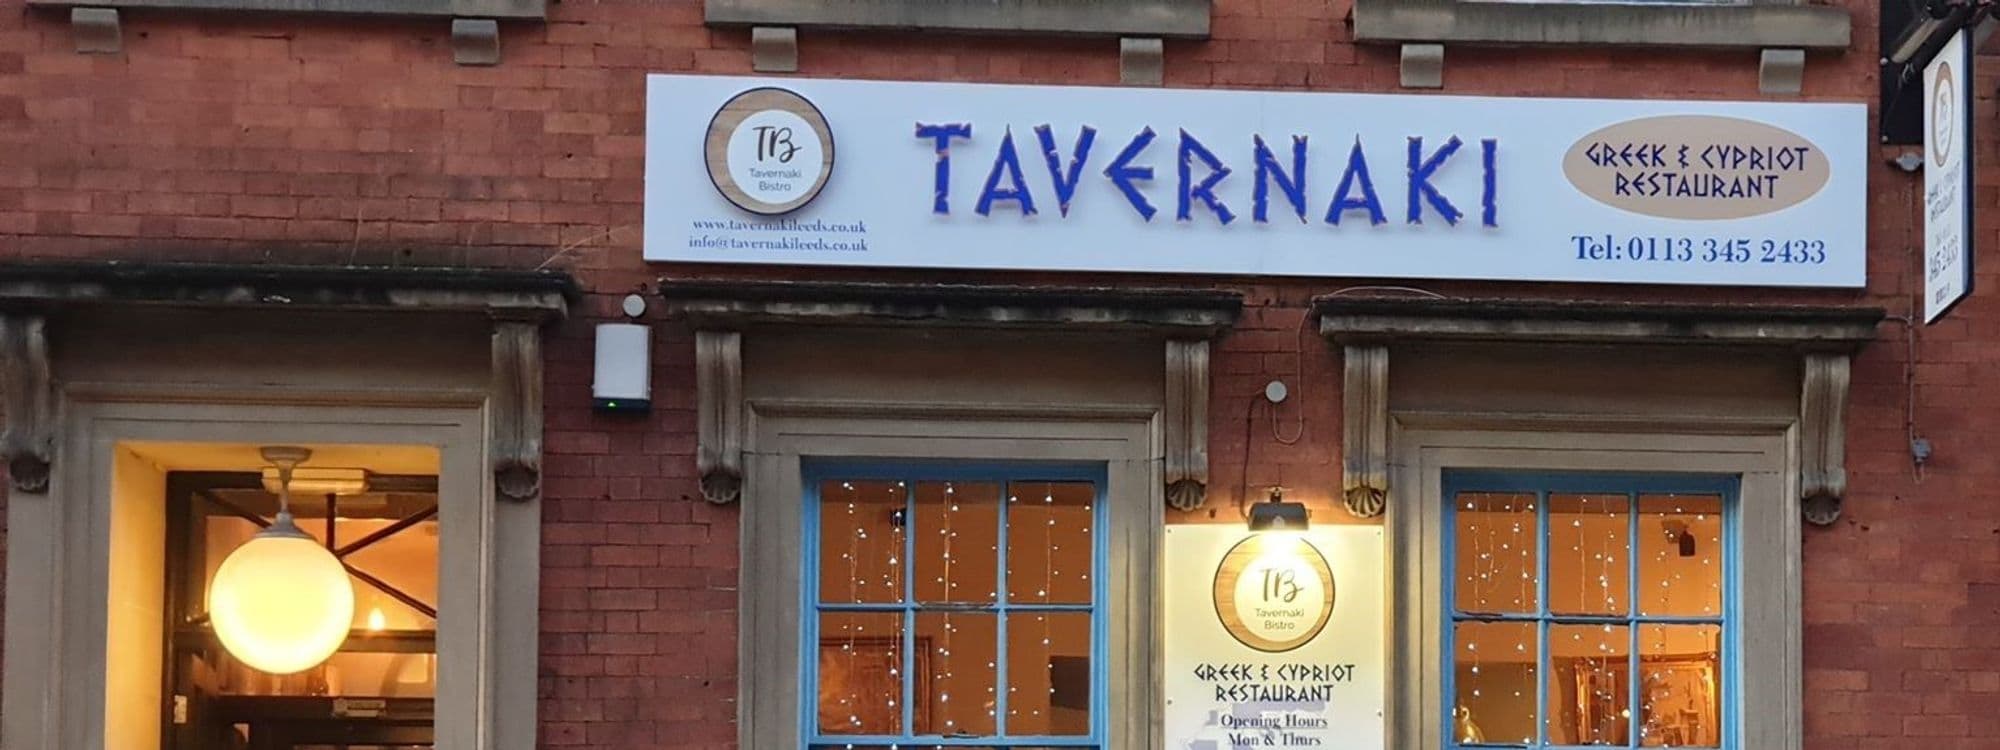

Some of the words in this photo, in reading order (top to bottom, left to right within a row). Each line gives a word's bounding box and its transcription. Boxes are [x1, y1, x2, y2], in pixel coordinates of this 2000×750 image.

[752, 126, 802, 163] TB
[1585, 142, 1667, 168] GREEK
[1700, 145, 1810, 171] CYPRIOT
[749, 168, 802, 179] Tavernaki
[914, 121, 1500, 228] TAVERNAKI
[758, 181, 792, 192] Bistro
[1615, 171, 1779, 199] RESTAURANT
[692, 218, 867, 234] www.tavernakileeds.co.uk
[1571, 234, 1622, 260] Tel:
[1628, 236, 1693, 262] 0113
[1702, 238, 1750, 262] 345
[1760, 239, 1826, 264] 2433
[1259, 567, 1305, 603] TB
[1255, 607, 1305, 618] Tavernaki
[1264, 620, 1296, 631] Bistro
[1194, 663, 1253, 681] GREEK
[1277, 664, 1356, 682] CYPRIOT
[1215, 684, 1334, 702] RESTAURANT
[1220, 713, 1281, 730] Opening
[1285, 714, 1328, 728] Hours
[1228, 732, 1260, 747] Mon
[1264, 732, 1276, 747] &
[1280, 733, 1322, 747] Thurs
